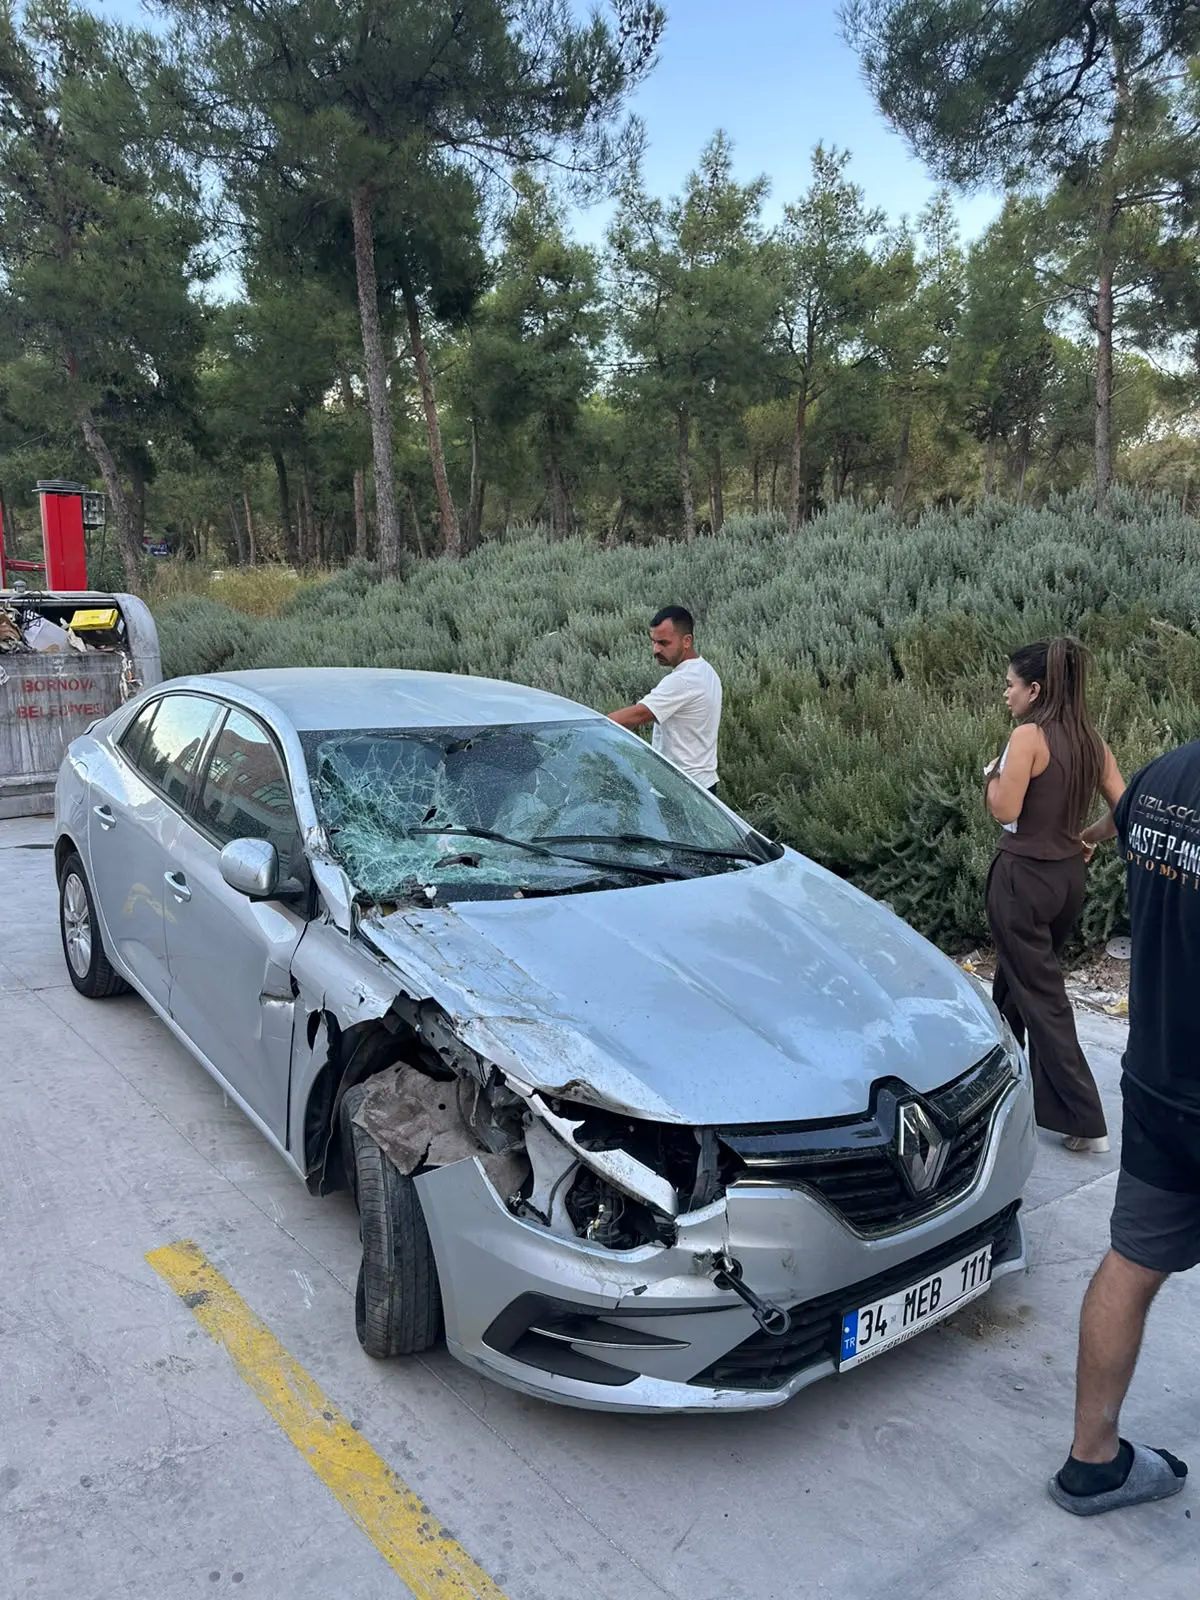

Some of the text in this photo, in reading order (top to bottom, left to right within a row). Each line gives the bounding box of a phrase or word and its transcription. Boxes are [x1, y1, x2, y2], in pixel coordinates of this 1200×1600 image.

[22, 679, 97, 693] BORNOVA
[858, 1251, 987, 1346] 34 MEB 111
[844, 1337, 856, 1350] TR
